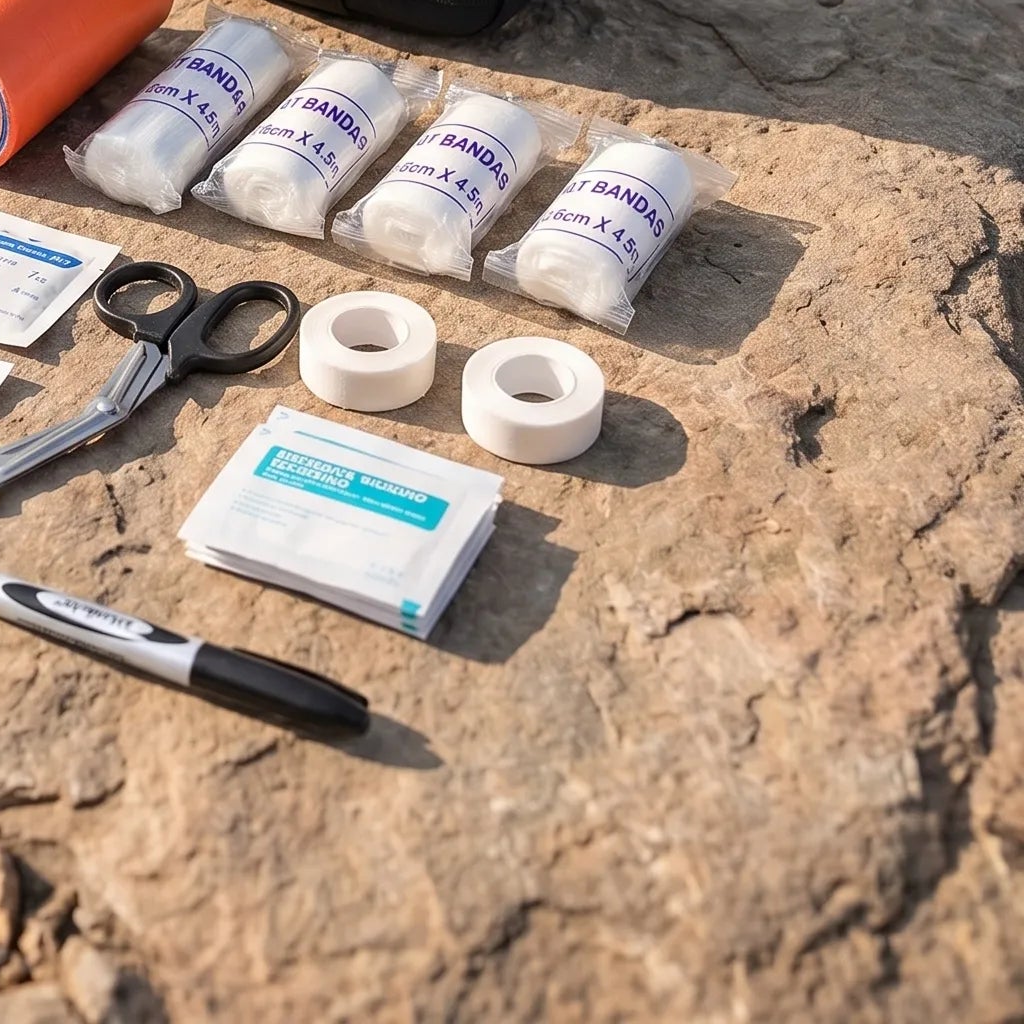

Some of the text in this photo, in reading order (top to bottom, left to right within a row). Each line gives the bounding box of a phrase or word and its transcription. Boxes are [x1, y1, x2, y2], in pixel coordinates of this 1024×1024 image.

[295, 131, 314, 146] X
[439, 134, 509, 191] BANDAS
[436, 167, 456, 182] X
[591, 180, 665, 238] BANDAS
[593, 216, 612, 233] X
